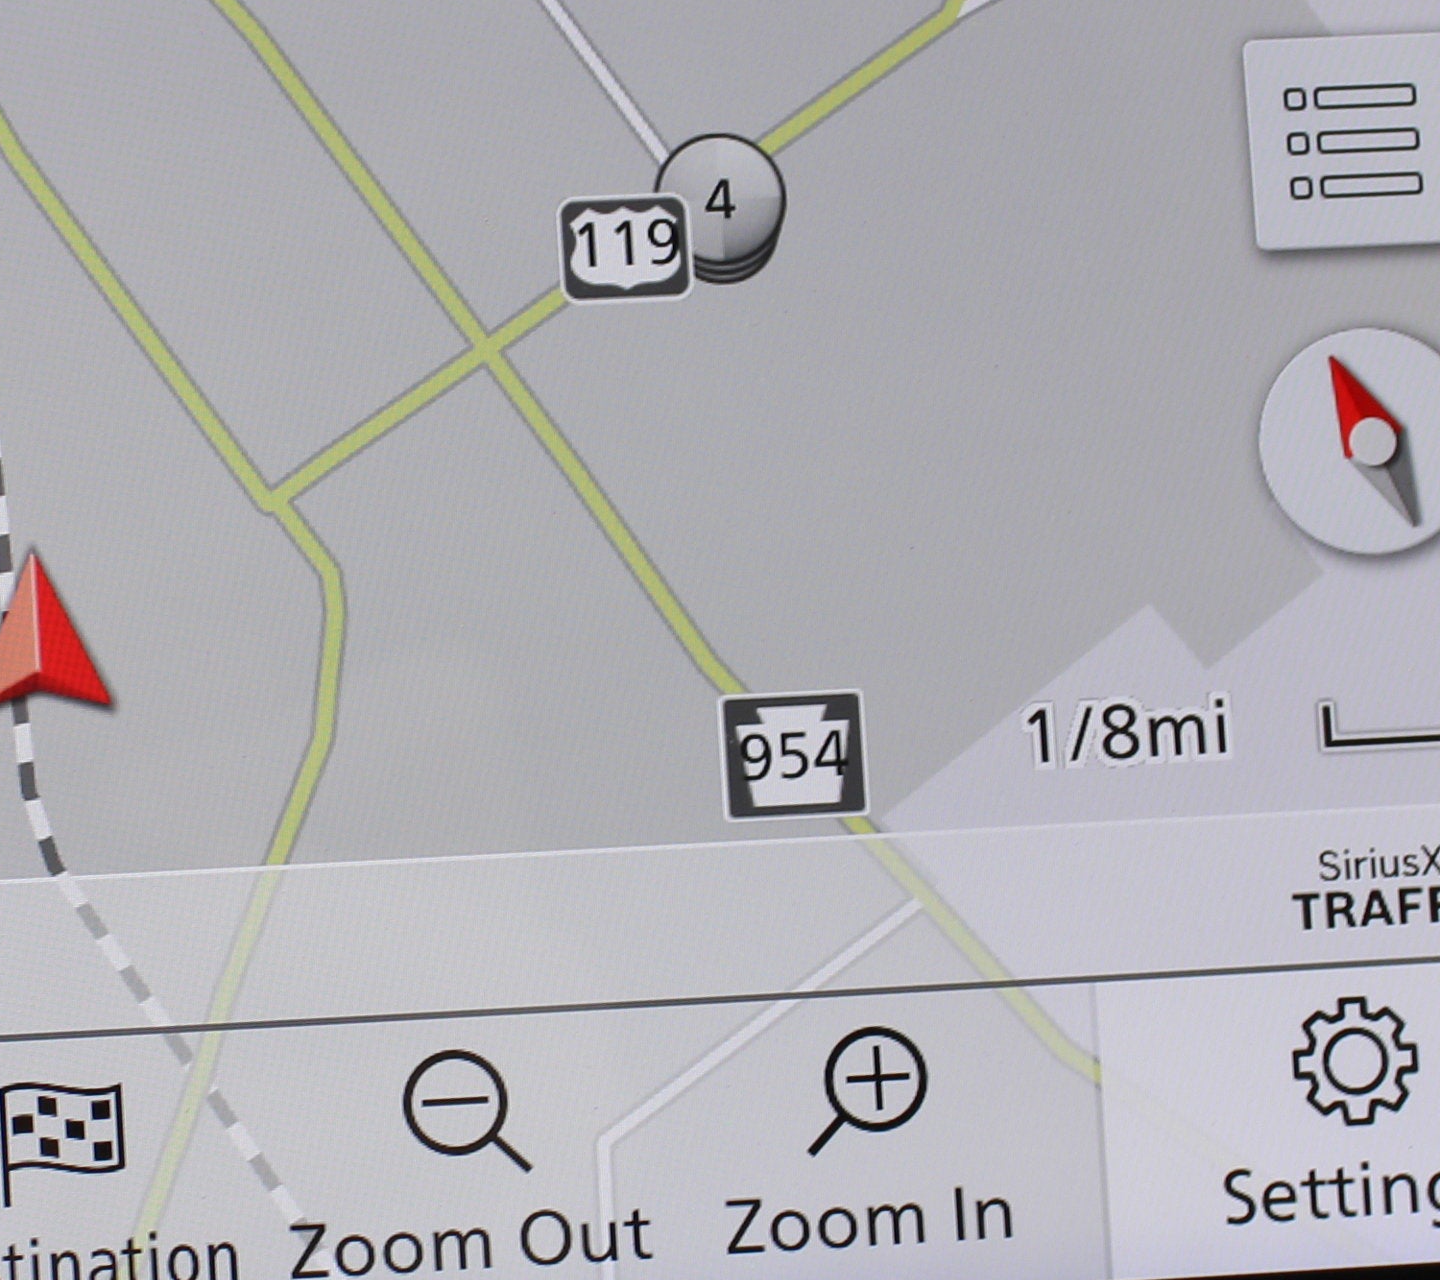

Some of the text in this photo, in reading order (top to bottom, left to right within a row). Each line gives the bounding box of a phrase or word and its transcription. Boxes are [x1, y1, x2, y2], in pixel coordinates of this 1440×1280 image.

[704, 176, 736, 219] 4
[575, 217, 680, 269] 119
[738, 728, 849, 782] 954
[1026, 697, 1227, 766] 1/8mi
[289, 1207, 654, 1280] Zoom Out
[726, 1188, 1014, 1256] Zoom In
